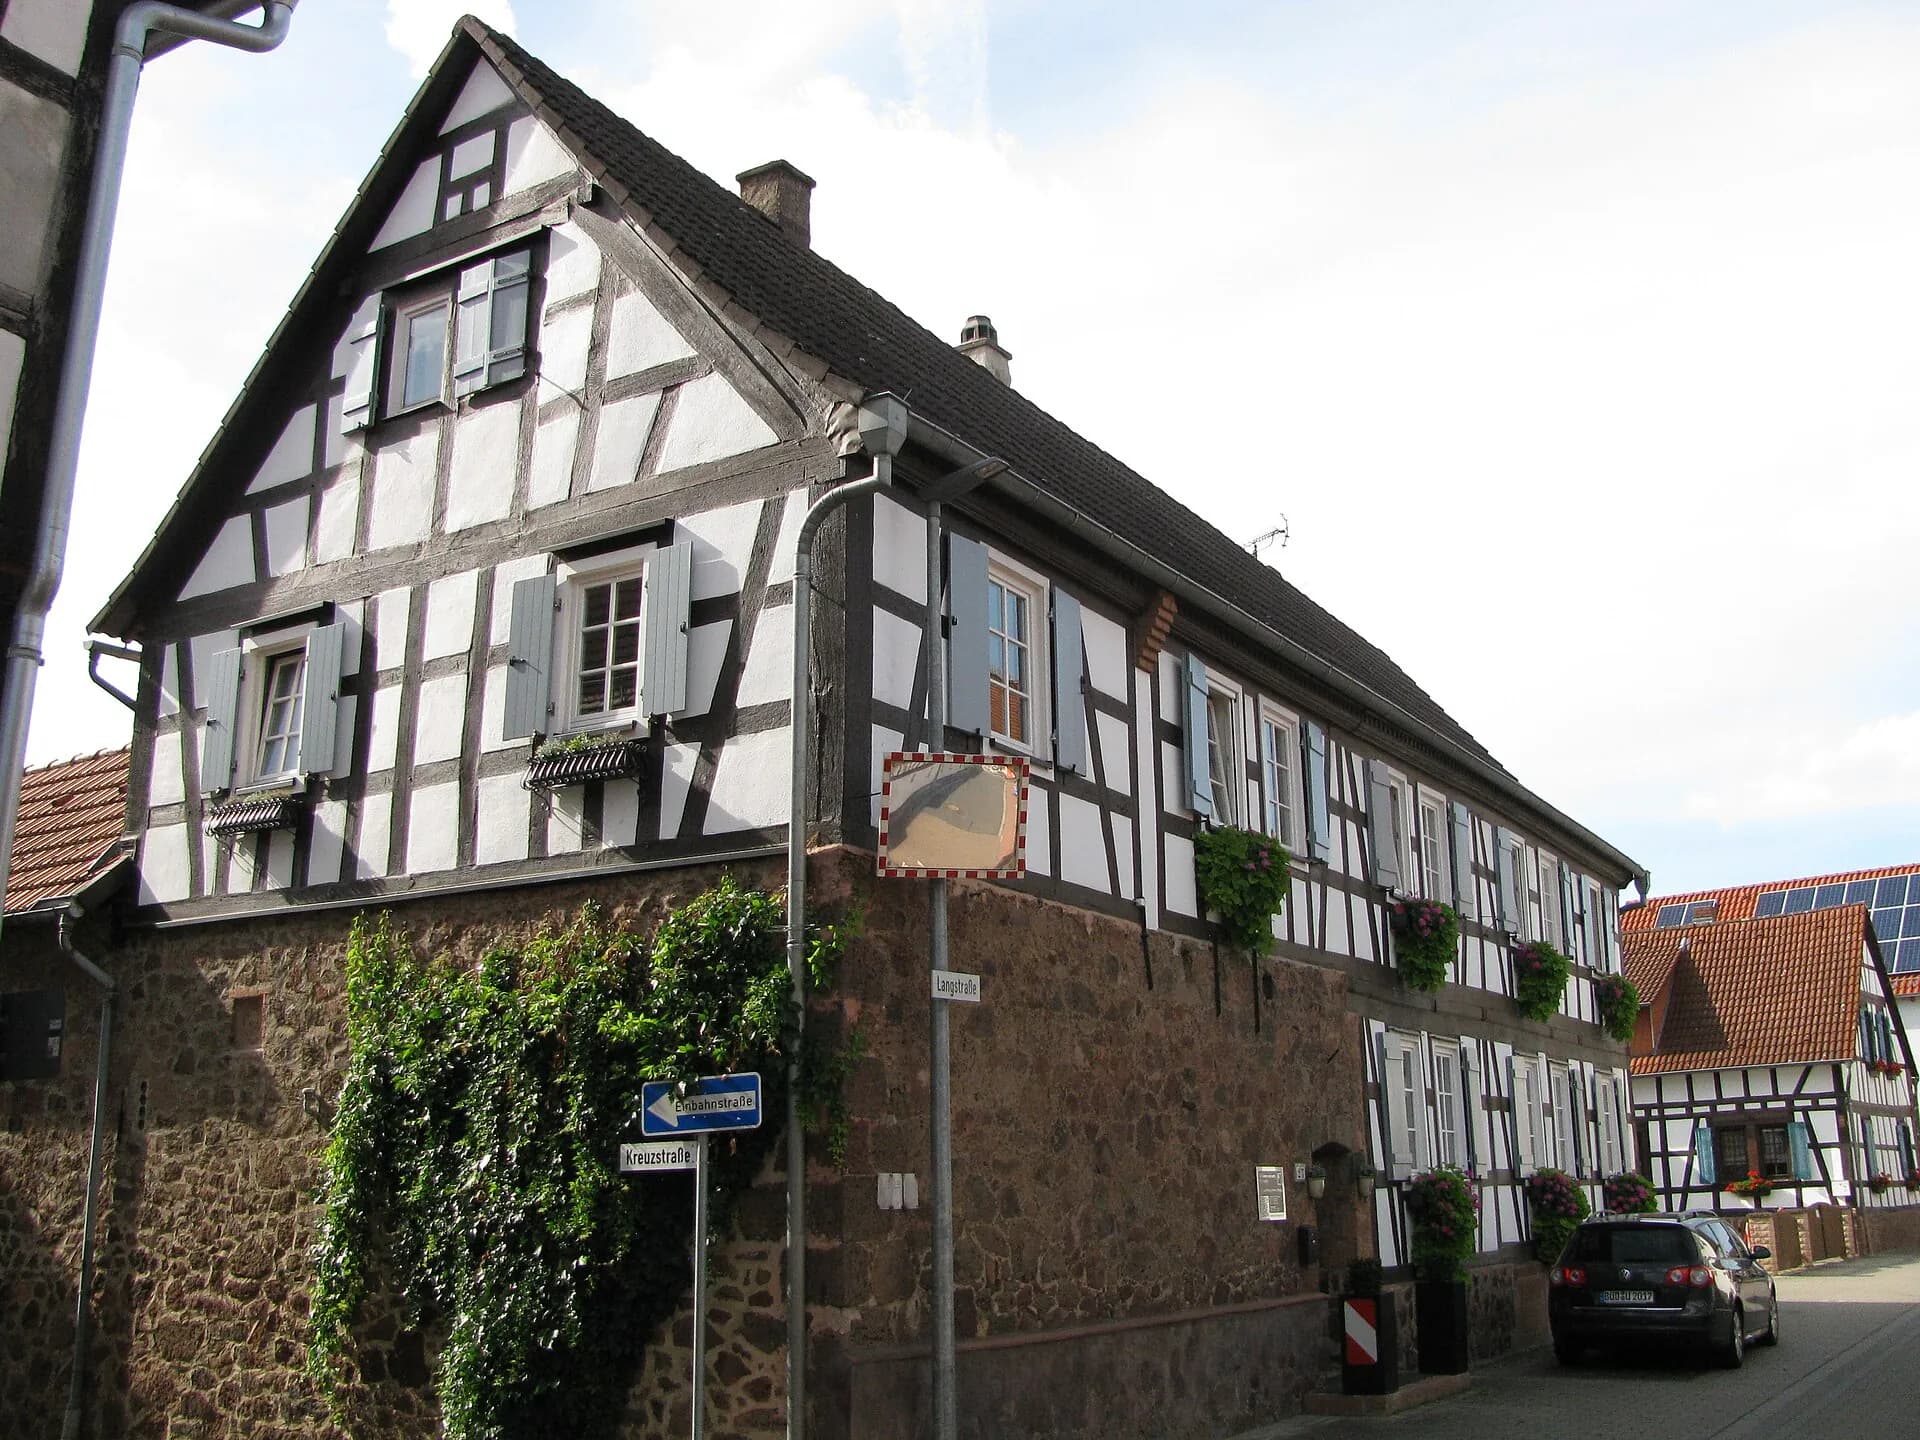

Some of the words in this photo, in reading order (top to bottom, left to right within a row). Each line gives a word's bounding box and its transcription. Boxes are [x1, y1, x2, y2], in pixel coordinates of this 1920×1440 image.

[936, 975, 977, 997] Langstraße
[675, 1095, 753, 1113] Einbahnstraße
[626, 1146, 691, 1166] Kreuzstraße
